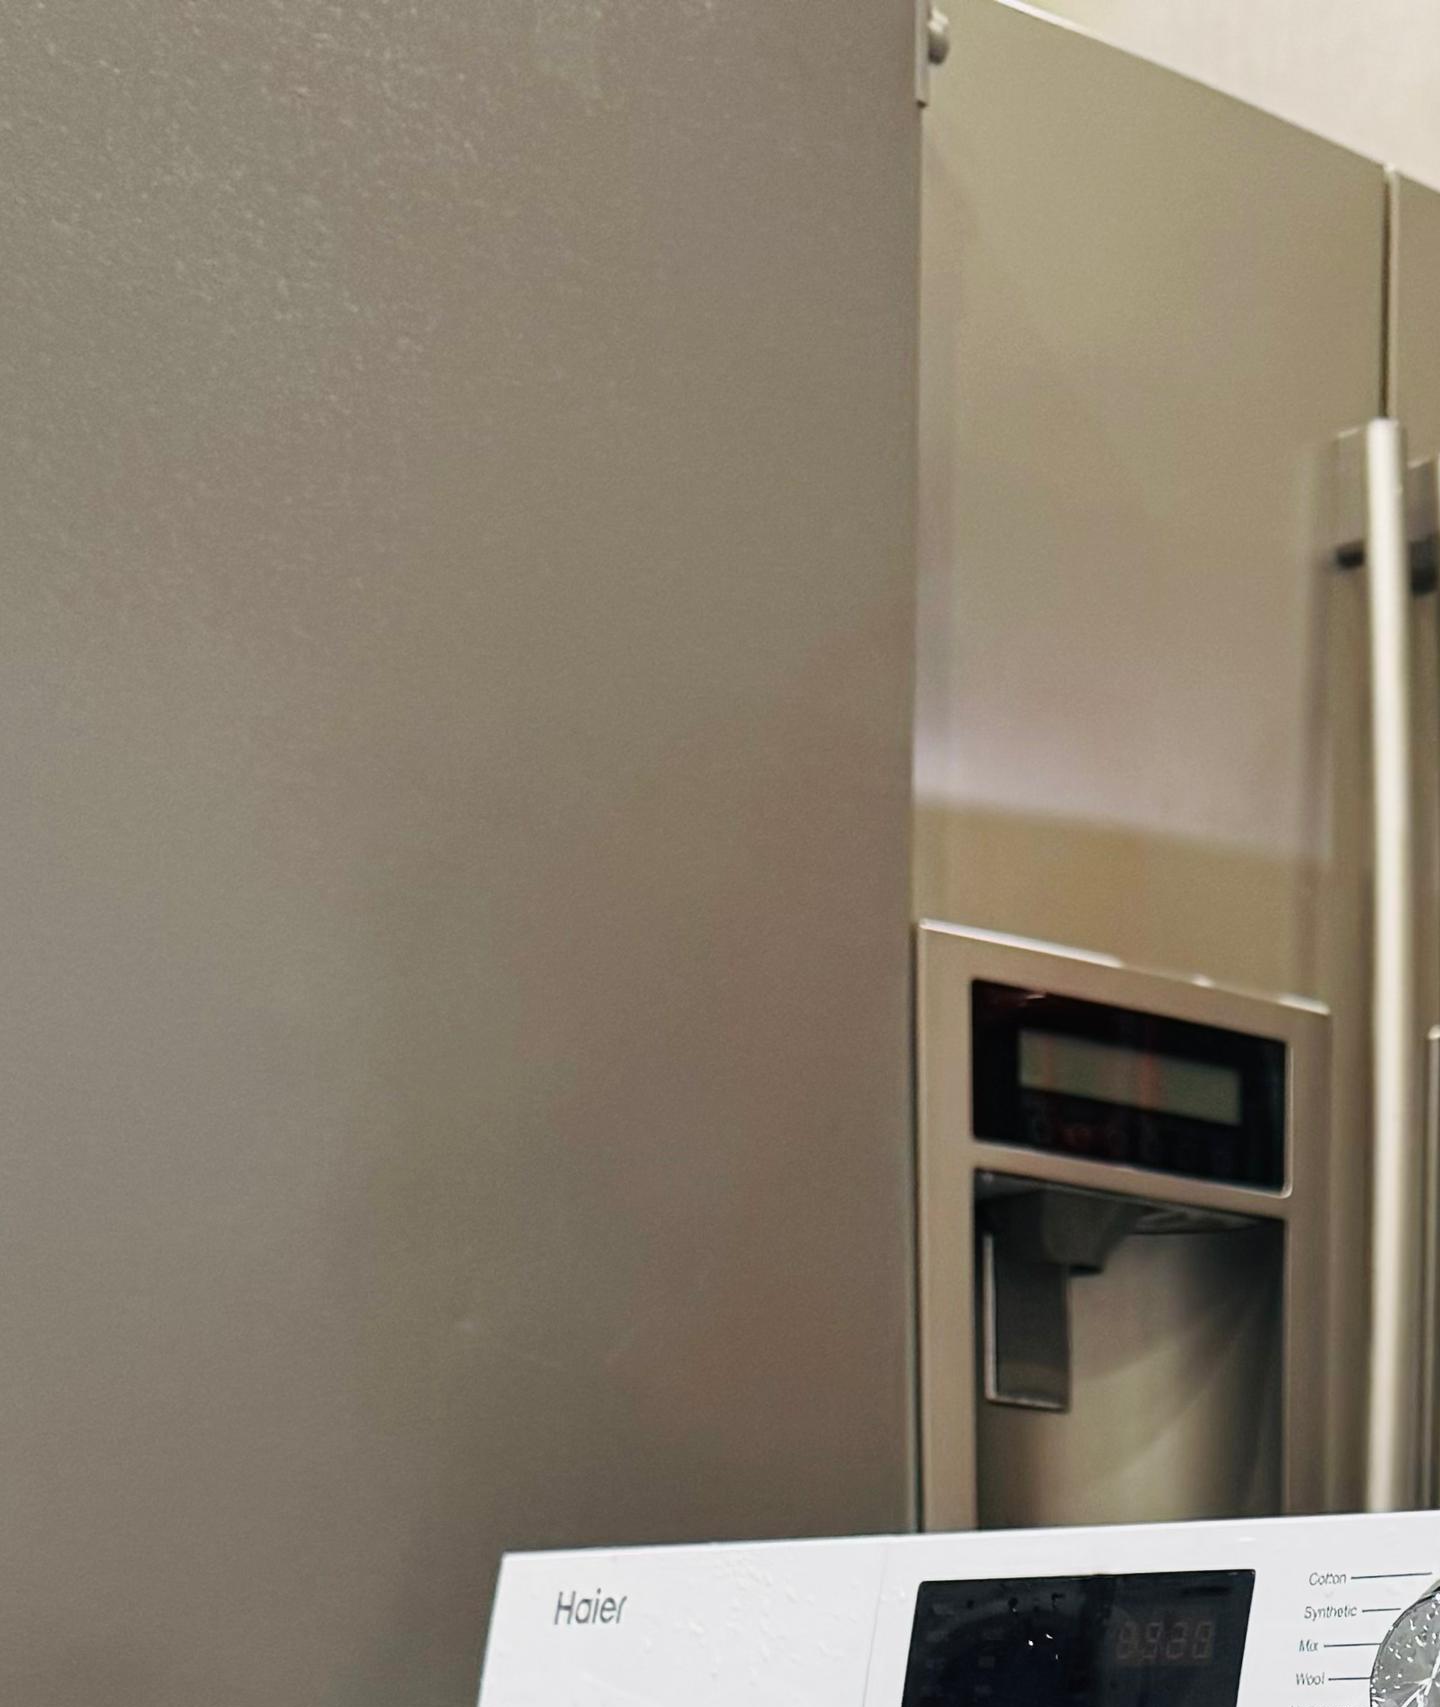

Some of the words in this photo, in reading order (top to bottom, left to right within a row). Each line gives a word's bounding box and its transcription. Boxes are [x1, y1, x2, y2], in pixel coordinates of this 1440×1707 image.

[1309, 1572, 1347, 1586] Cotton
[554, 1587, 628, 1626] Haier
[1304, 1605, 1358, 1622] Synthetic
[1296, 1672, 1325, 1686] Wool
